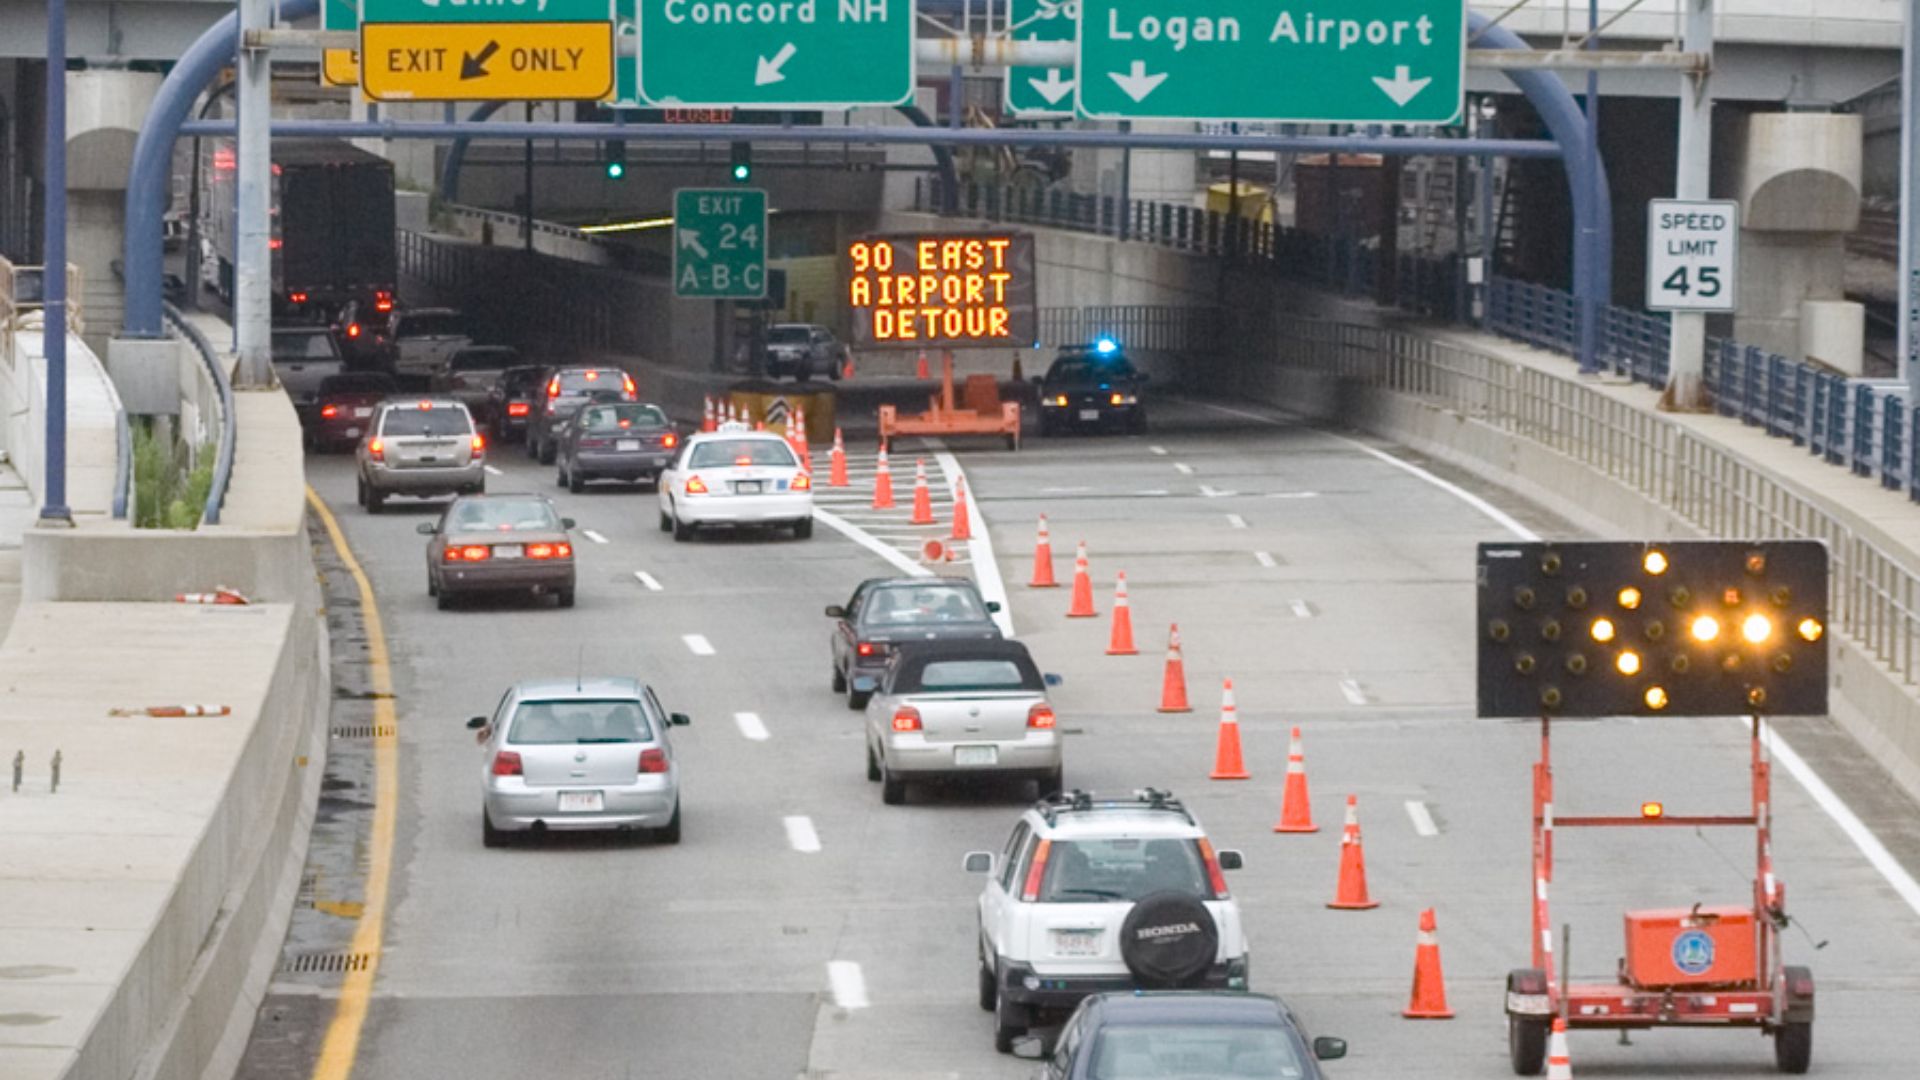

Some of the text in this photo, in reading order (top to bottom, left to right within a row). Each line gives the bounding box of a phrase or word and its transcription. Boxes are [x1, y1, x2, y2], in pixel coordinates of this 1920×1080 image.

[664, 0, 888, 24] Concord NH
[1107, 8, 1434, 51] Logan Airport
[387, 48, 448, 72] EXIT
[510, 48, 584, 72] ONLY
[664, 107, 734, 123] CLOSED
[698, 196, 743, 216] EXIT
[1660, 213, 1726, 231] SPEED
[719, 222, 758, 250] 24
[1667, 240, 1718, 256] LIMIT
[850, 239, 1010, 272] 90 EAST
[680, 262, 761, 290] A-B-C
[1663, 265, 1721, 298] 45
[851, 273, 1011, 306] AIRPORT
[874, 307, 1010, 339] DETOUR
[1136, 922, 1201, 940] HONDA
